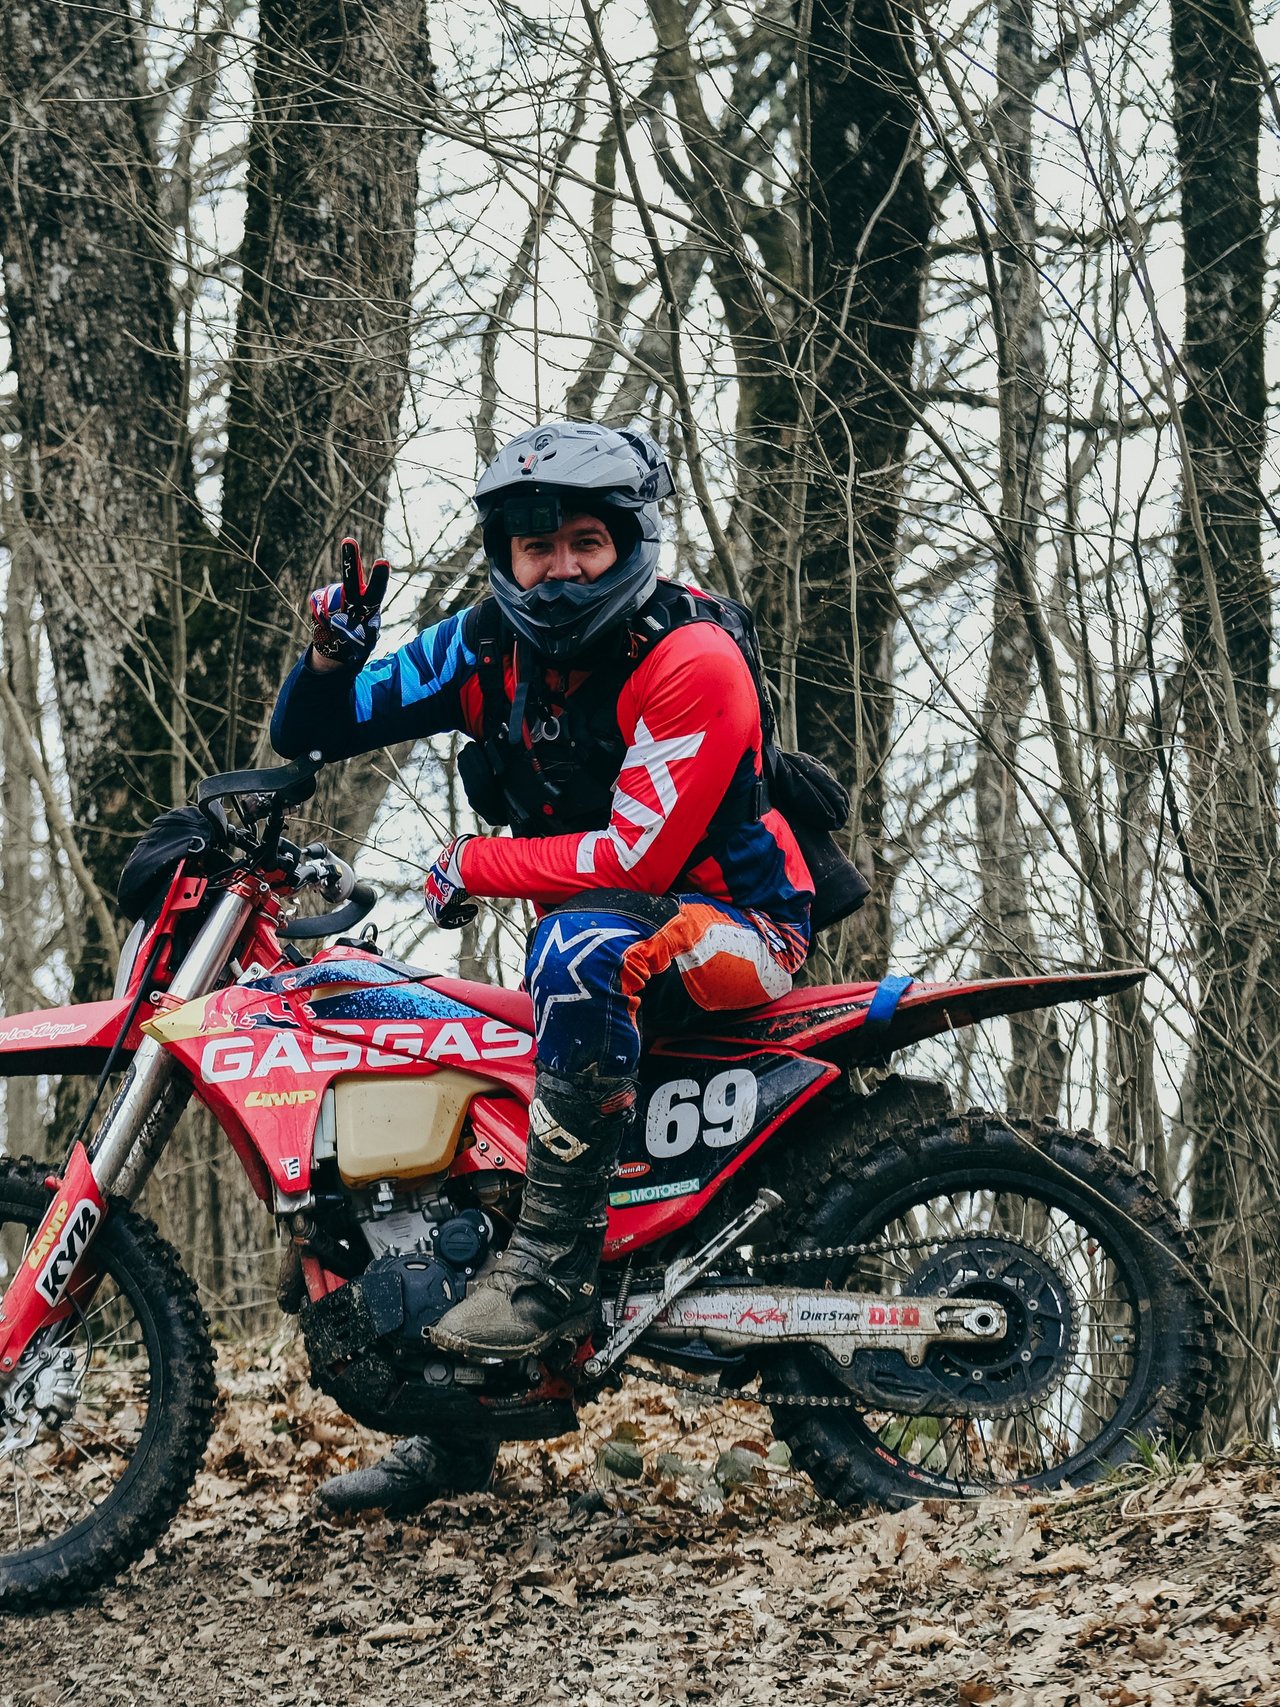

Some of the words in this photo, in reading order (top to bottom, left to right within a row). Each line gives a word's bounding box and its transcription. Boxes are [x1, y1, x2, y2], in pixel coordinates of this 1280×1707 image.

[7, 1028, 33, 1041] Lee
[201, 1021, 534, 1084] GASGAS
[646, 1069, 757, 1158] 69
[631, 1180, 699, 1202] MOTOREX
[41, 1206, 97, 1301] KYB
[697, 1310, 728, 1320] brembo
